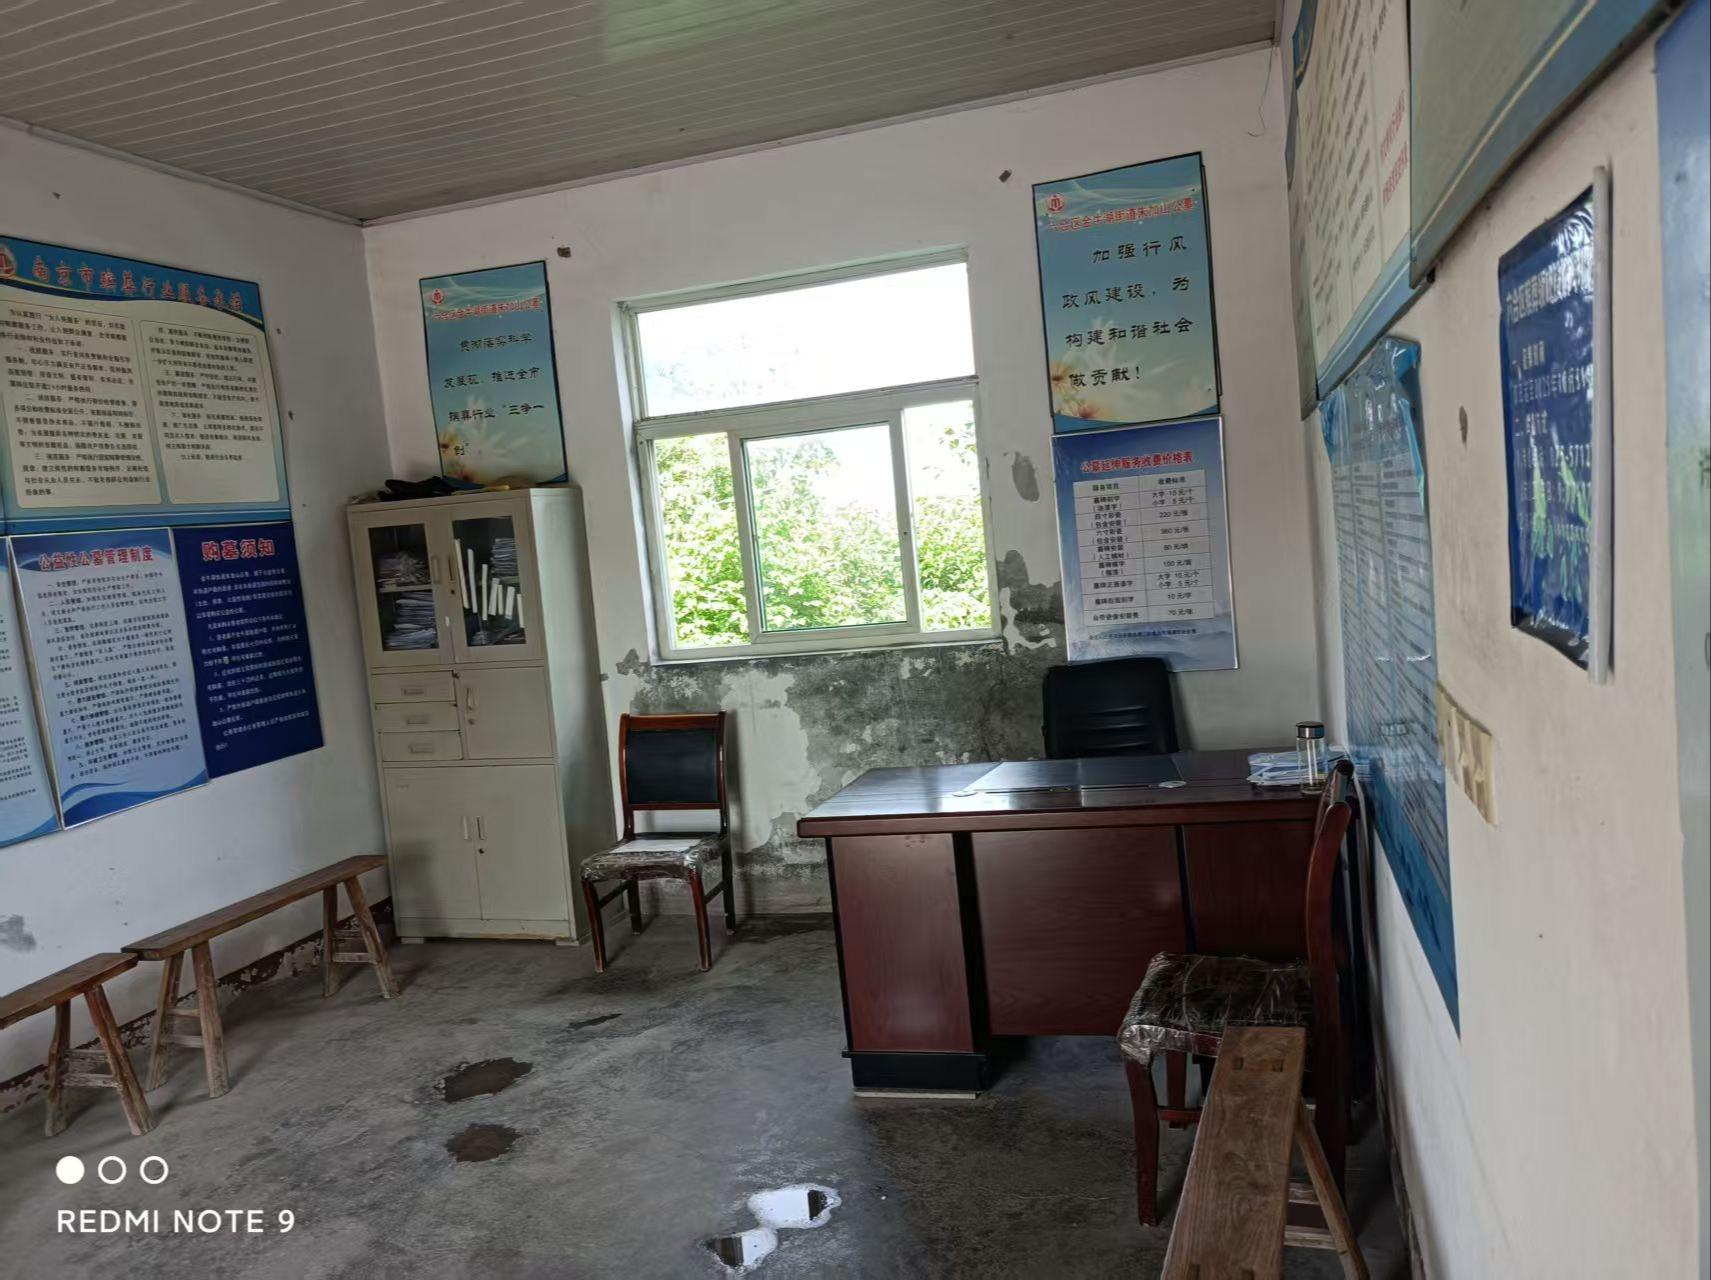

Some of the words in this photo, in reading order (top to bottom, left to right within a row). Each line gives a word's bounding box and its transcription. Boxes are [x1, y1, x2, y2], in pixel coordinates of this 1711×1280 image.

[1092, 235, 1187, 263] 加强行风
[1065, 317, 1193, 347] 构建和谐社会
[38, 545, 154, 572] 公益性公墓管理制度
[201, 538, 276, 562] 购墓须知
